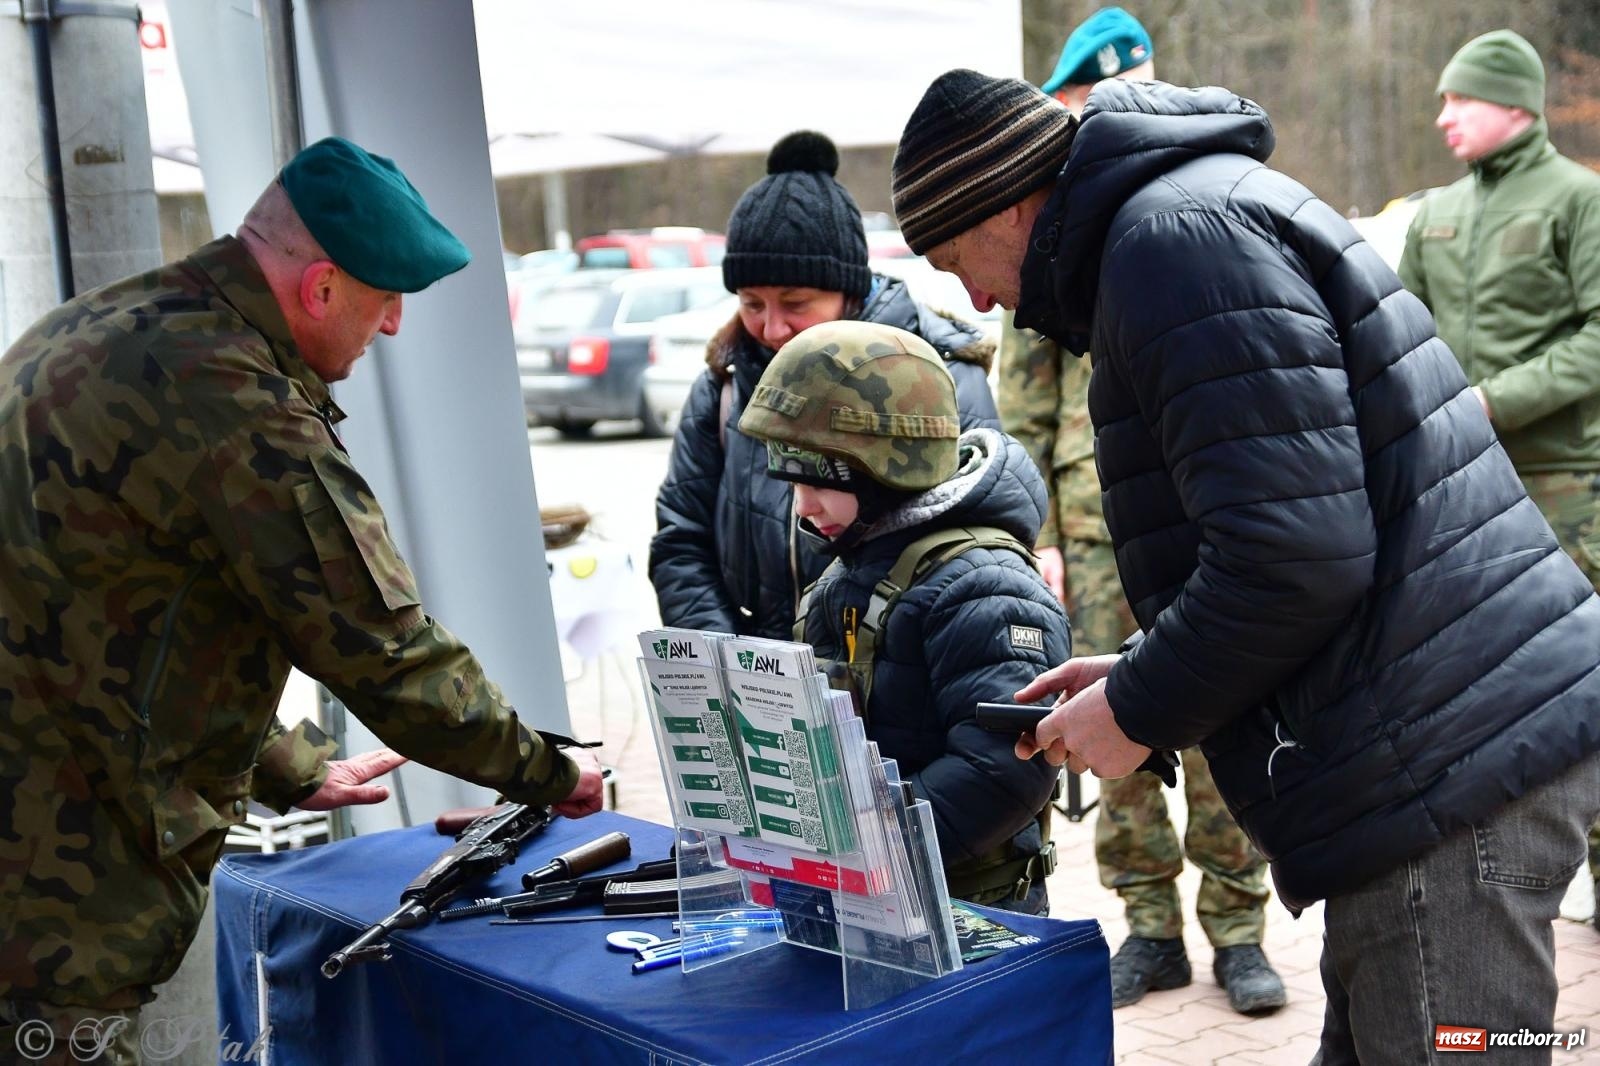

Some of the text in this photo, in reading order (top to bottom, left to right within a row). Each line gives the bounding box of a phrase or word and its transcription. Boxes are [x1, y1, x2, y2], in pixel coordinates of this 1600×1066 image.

[1014, 628, 1040, 642] DKNY
[670, 640, 698, 659] AWL
[755, 654, 785, 677] AWL
